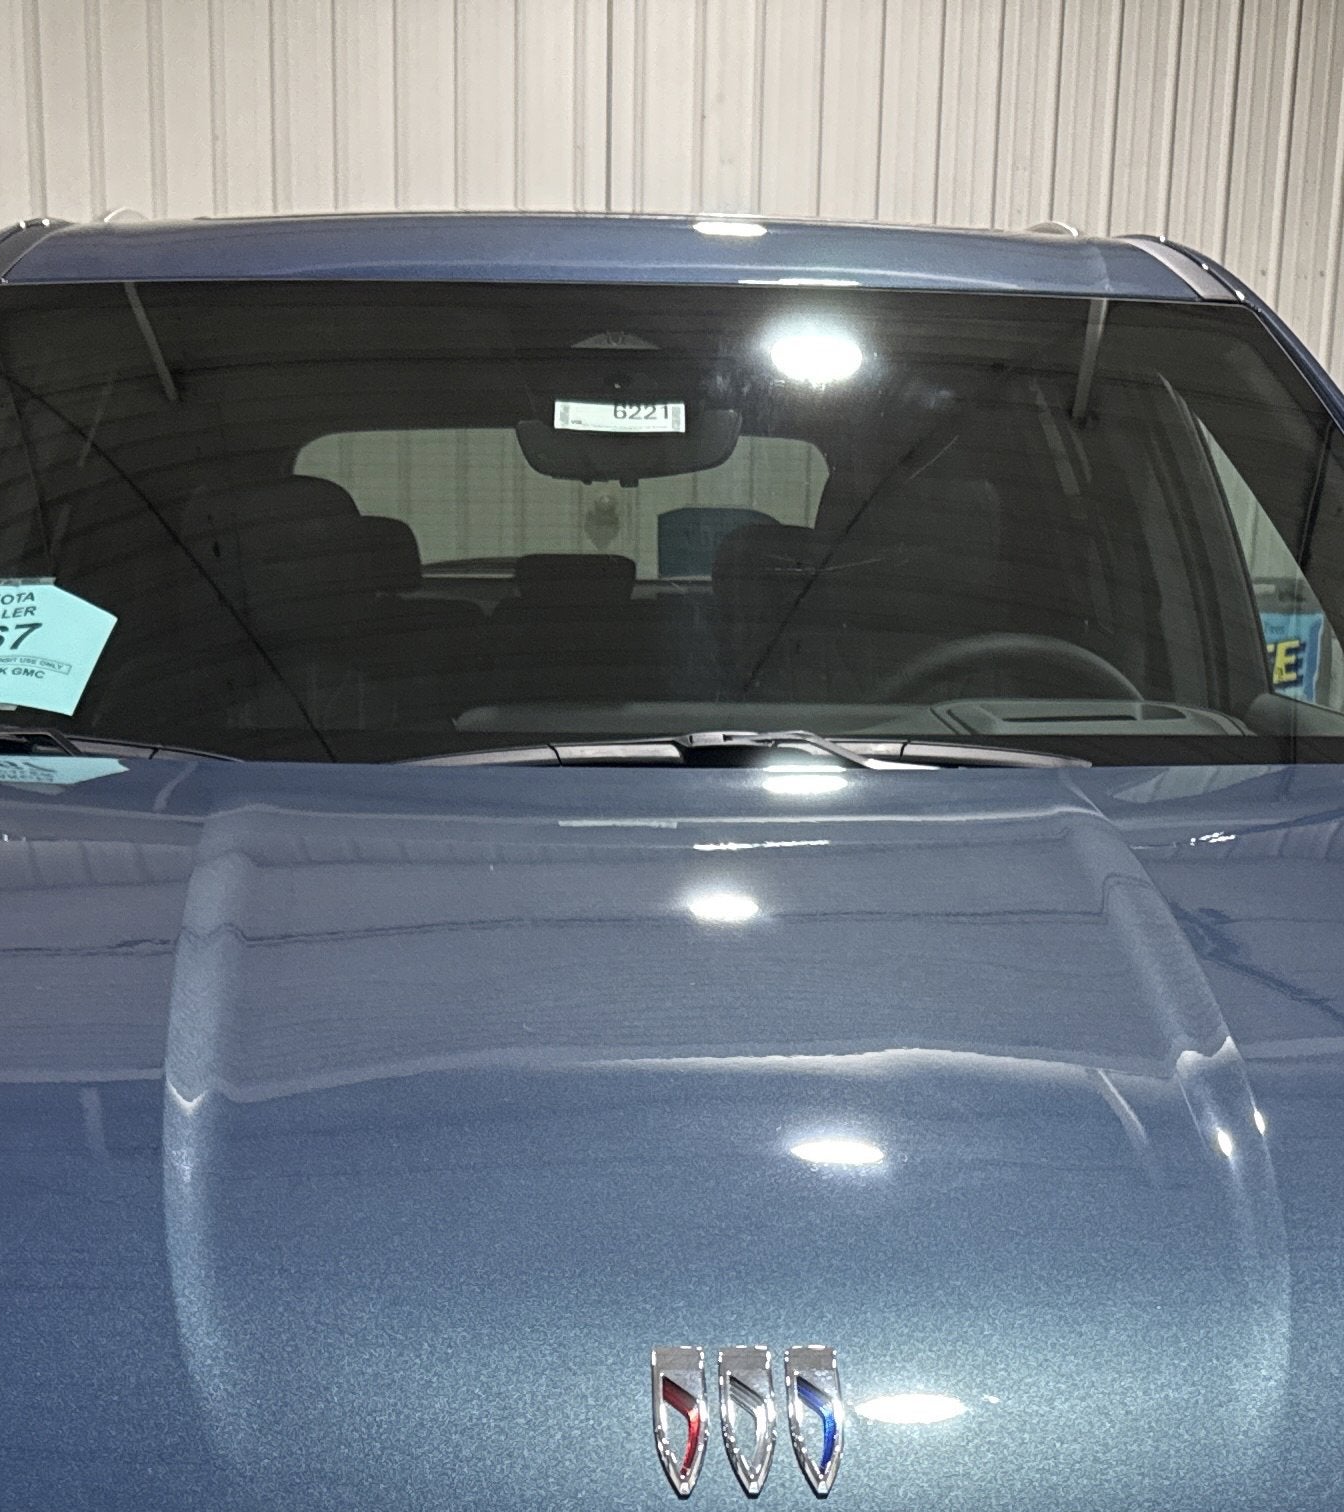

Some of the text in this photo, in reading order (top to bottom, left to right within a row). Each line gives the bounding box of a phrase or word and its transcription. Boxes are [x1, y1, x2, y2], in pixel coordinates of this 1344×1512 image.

[613, 402, 669, 420] 6221
[19, 657, 36, 665] USE
[39, 660, 64, 670] ONLY
[11, 667, 46, 679] GMC
